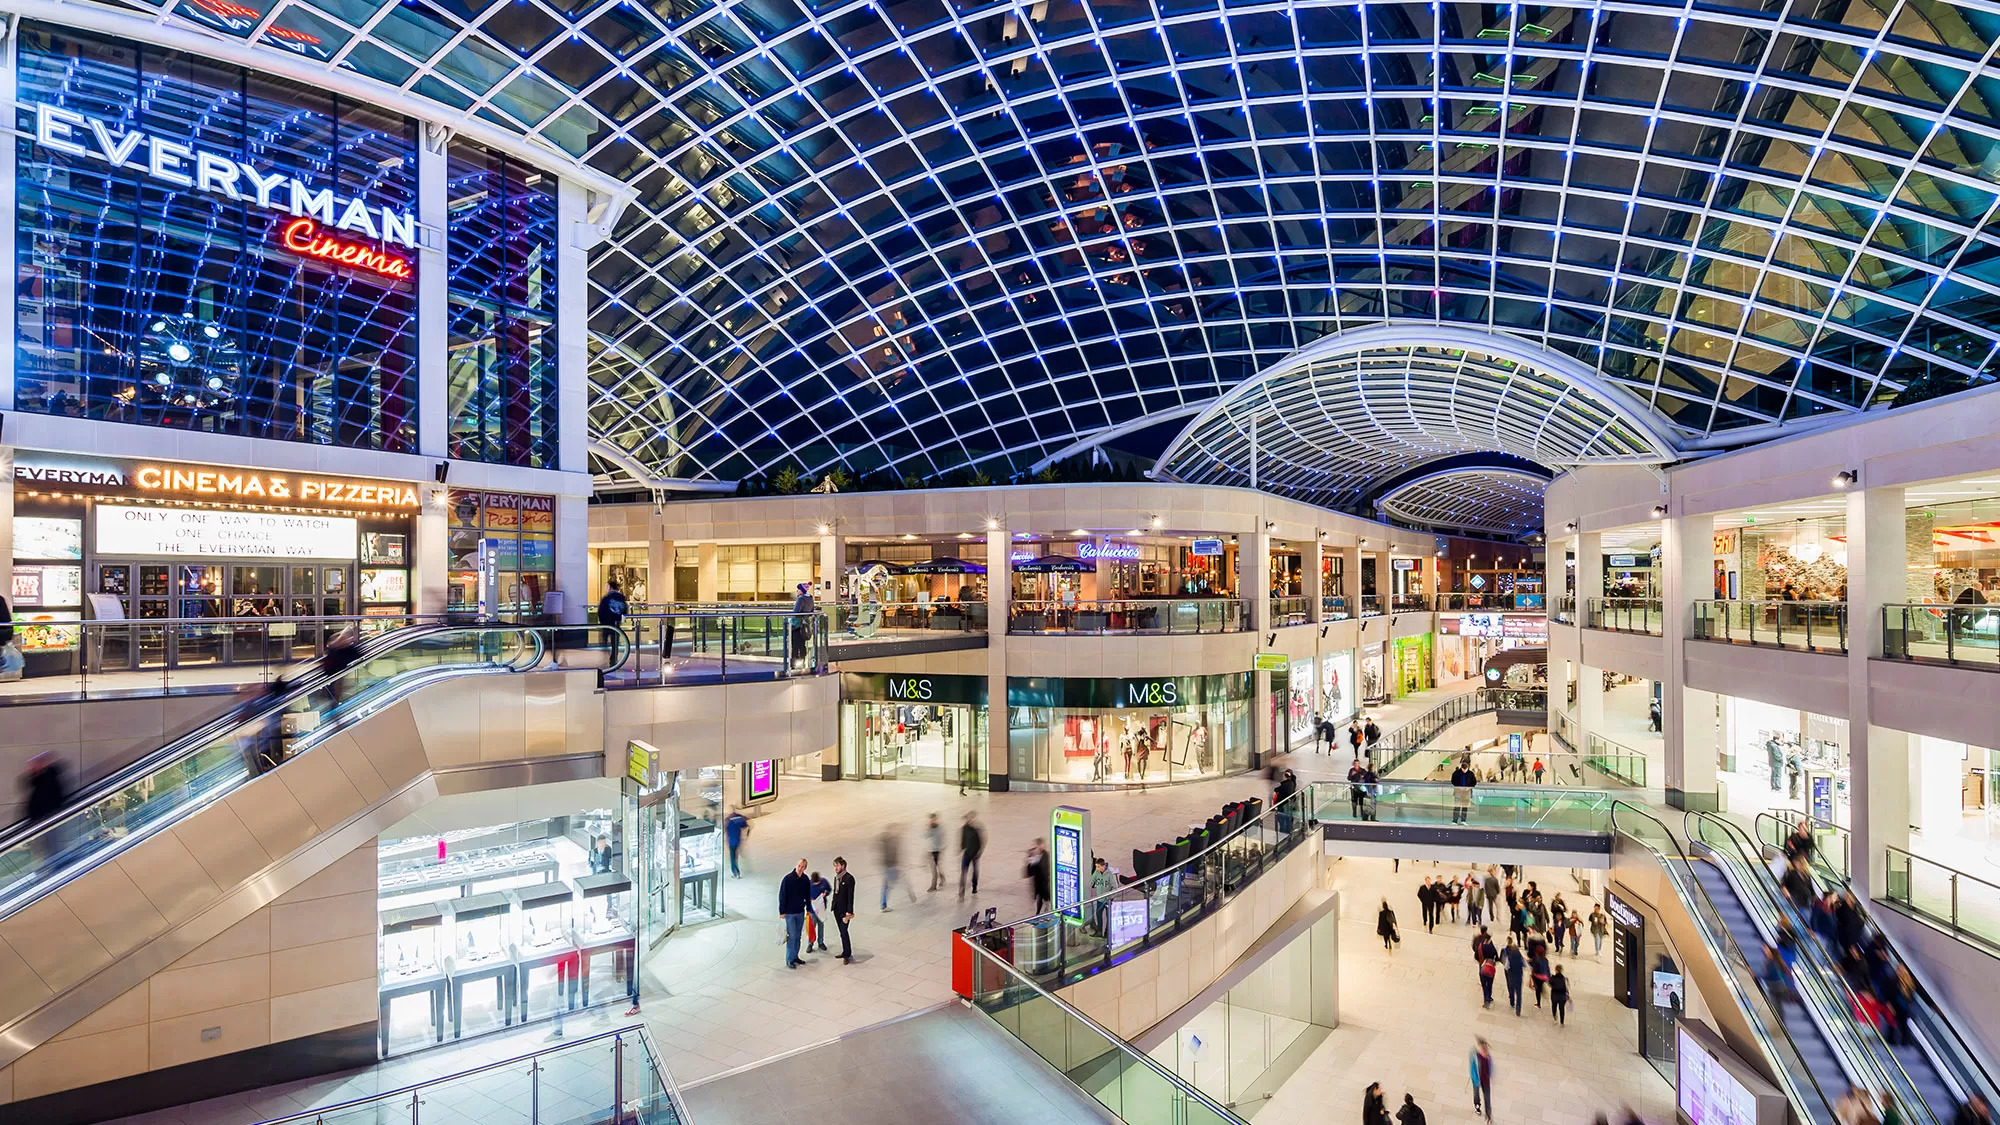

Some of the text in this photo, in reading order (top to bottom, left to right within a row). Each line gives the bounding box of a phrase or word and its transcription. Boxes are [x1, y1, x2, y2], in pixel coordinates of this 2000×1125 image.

[36, 101, 415, 249] EVERYMAN
[284, 219, 411, 279] Cinema
[138, 468, 419, 506] CINEMA & PIZZERIA
[468, 492, 551, 511] EVERYMAN
[124, 510, 330, 529] ONLY ONE WAY TO WATCH
[175, 528, 272, 541] ONE CHANCE
[156, 542, 314, 556] THE EVERYMAN WAY
[889, 679, 932, 700] M&S
[1129, 682, 1177, 704] M&S
